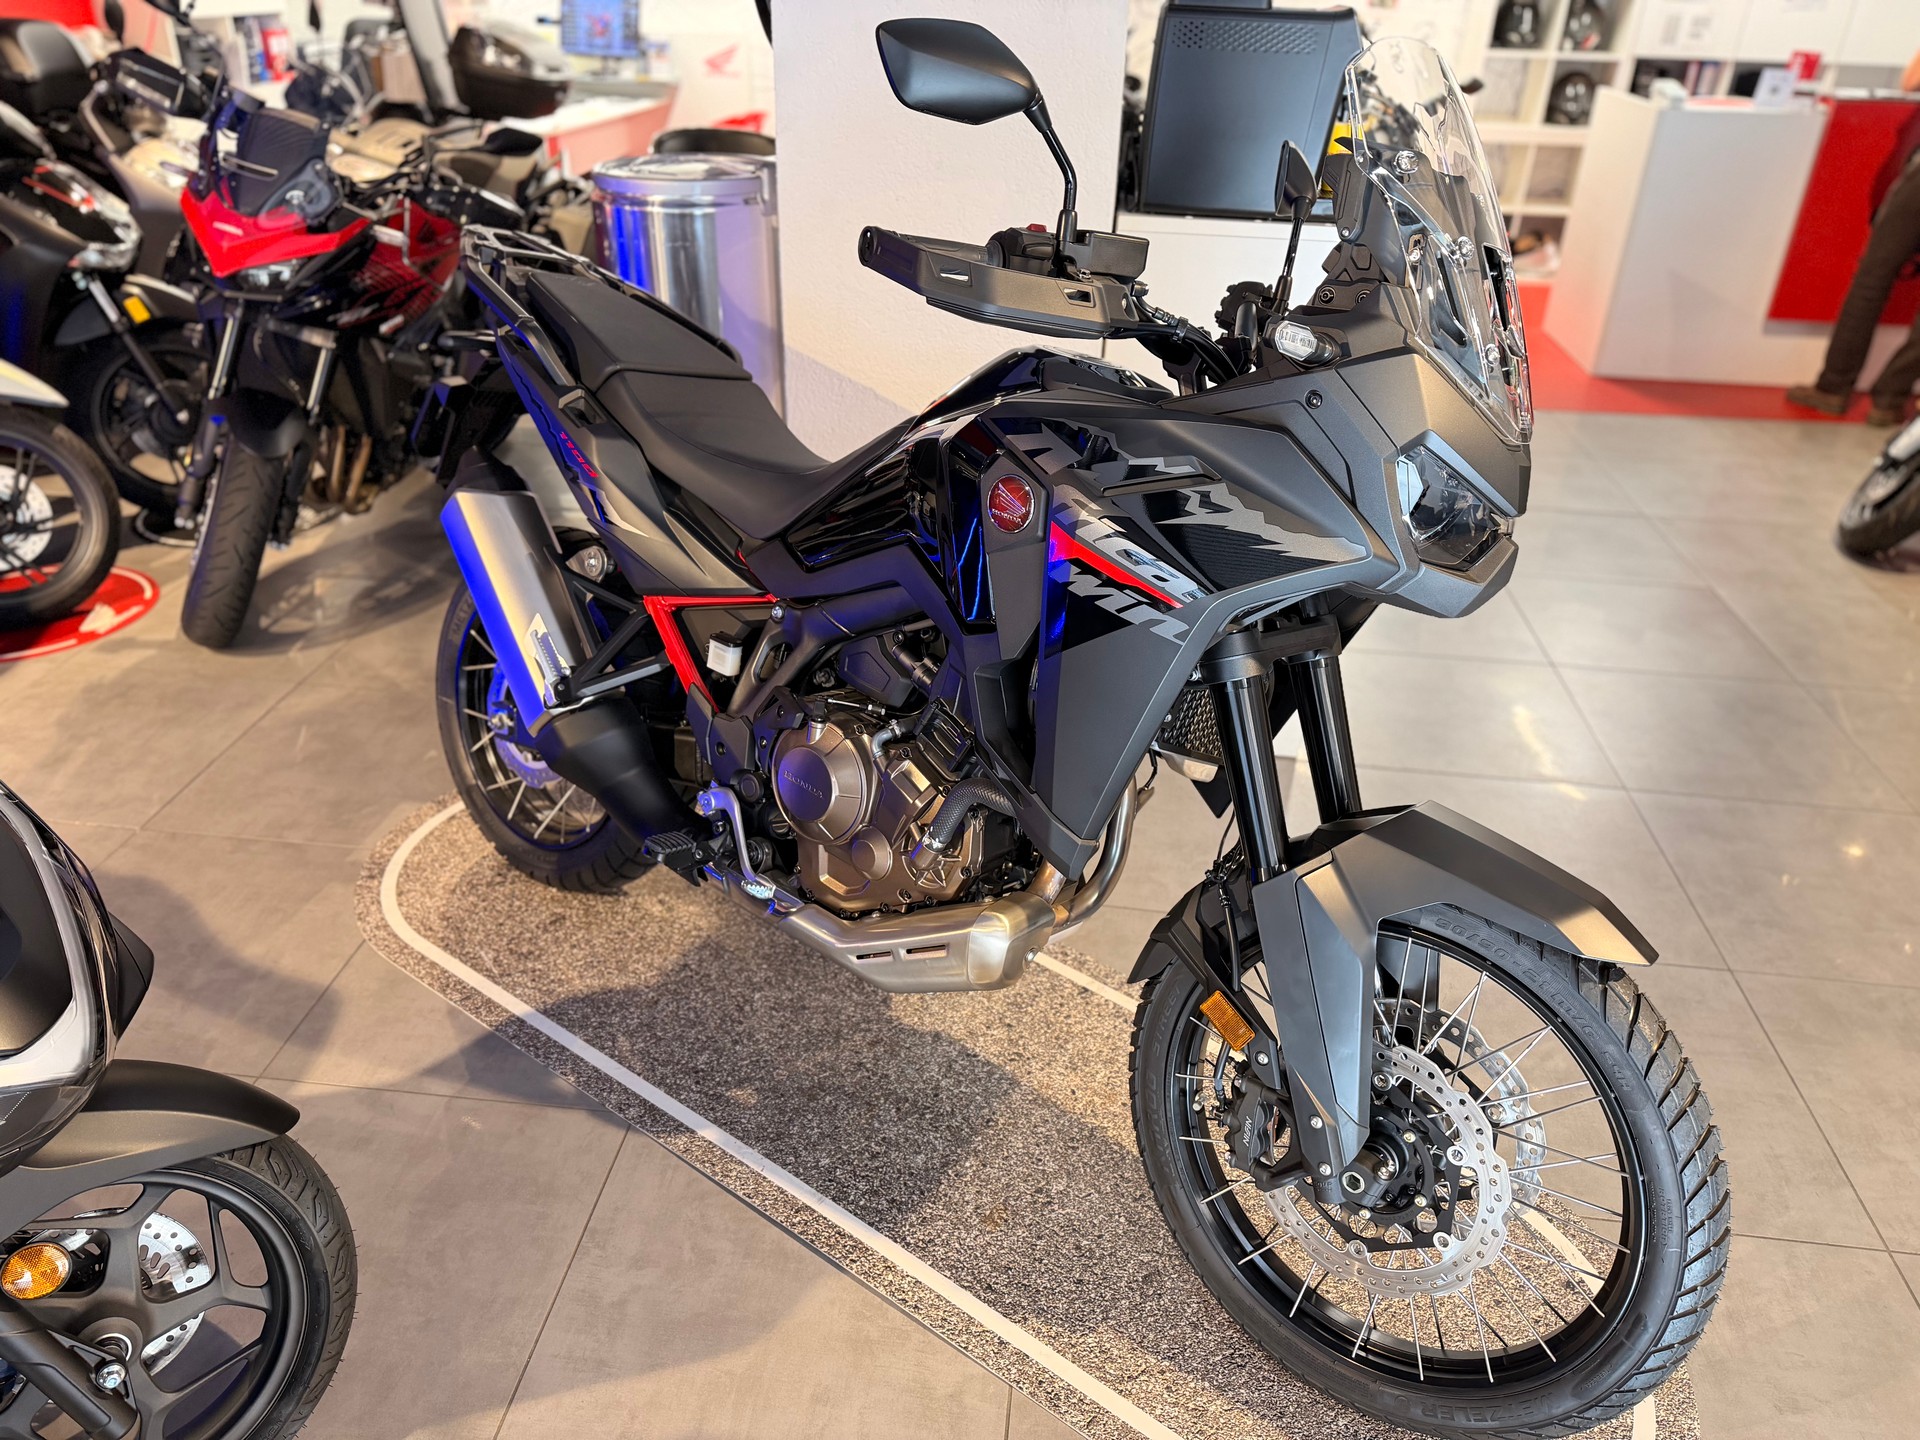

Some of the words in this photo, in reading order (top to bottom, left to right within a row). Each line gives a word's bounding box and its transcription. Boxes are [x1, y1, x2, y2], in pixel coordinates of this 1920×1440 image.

[560, 431, 599, 478] 1100
[992, 508, 1023, 525] HONDA
[1052, 484, 1196, 603] frica
[1051, 560, 1190, 645] win
[784, 769, 824, 799] HONDA
